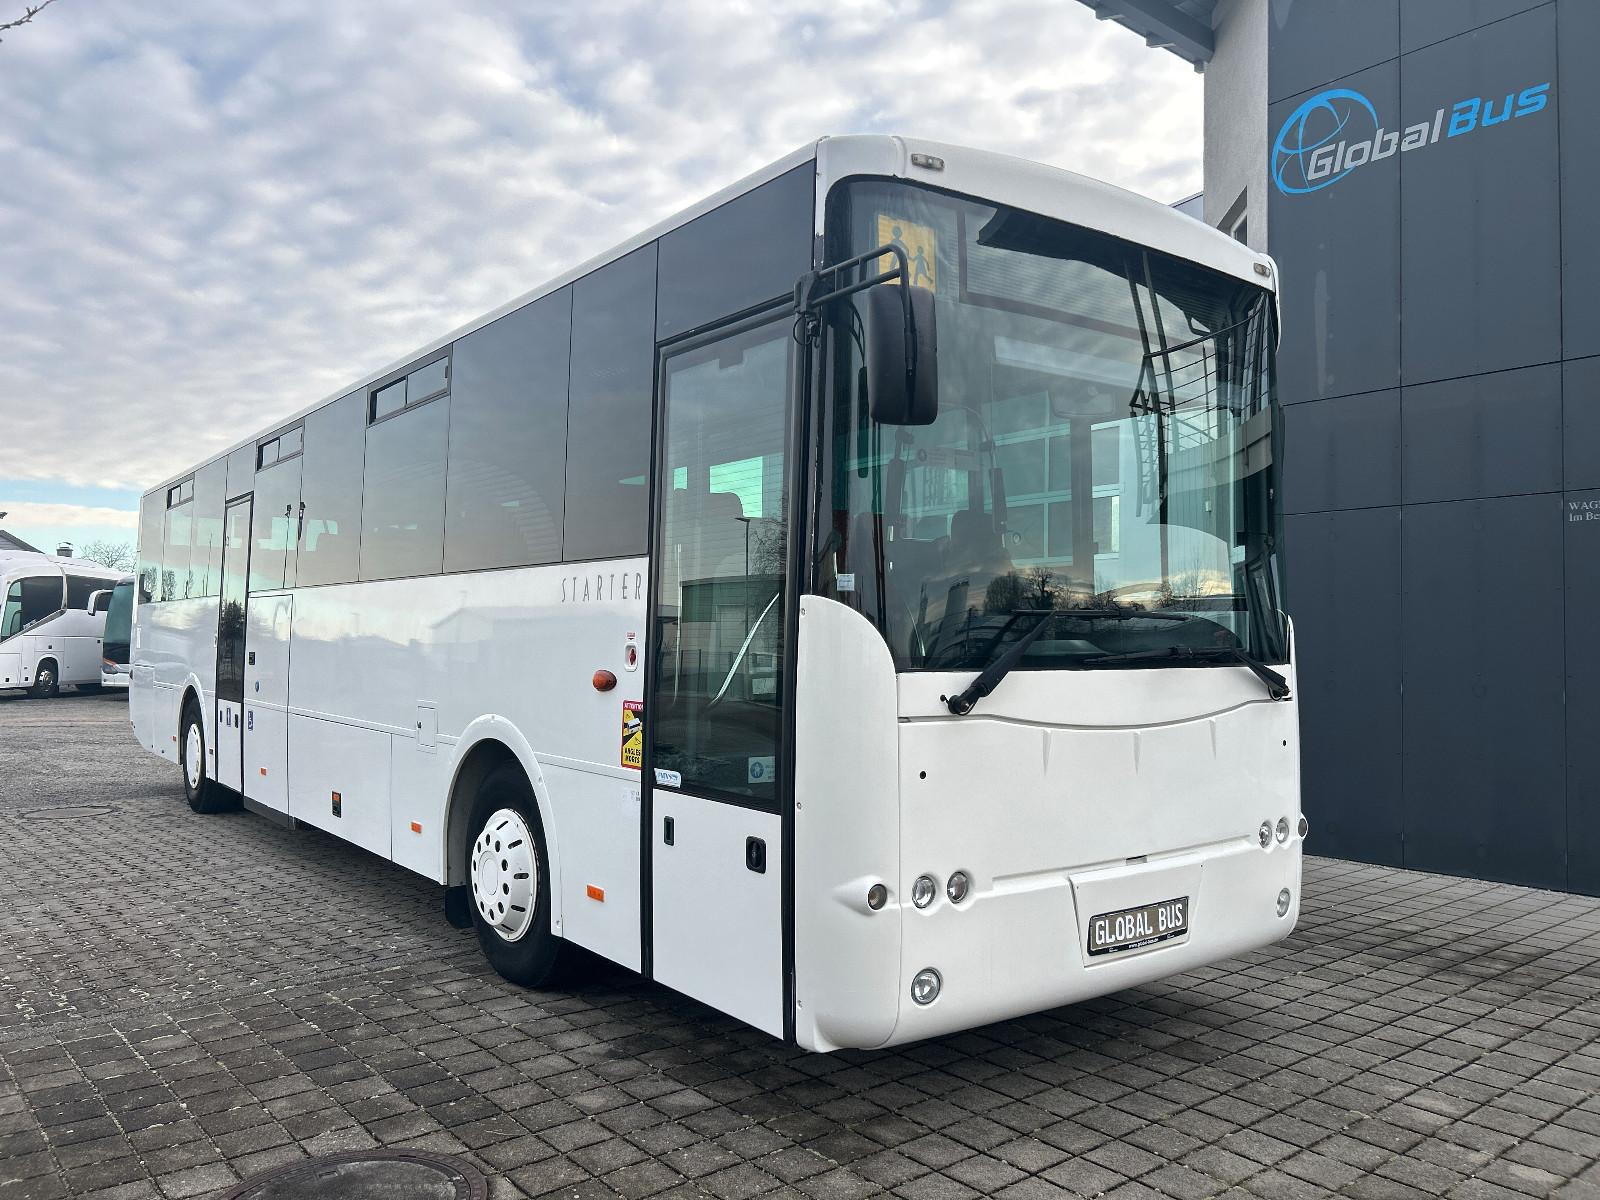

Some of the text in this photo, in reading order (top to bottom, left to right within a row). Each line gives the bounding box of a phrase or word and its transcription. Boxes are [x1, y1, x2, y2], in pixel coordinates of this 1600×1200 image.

[1568, 500, 1600, 510] WAG
[1569, 512, 1583, 522] Im
[561, 572, 642, 602] STARTER
[1095, 903, 1183, 945] GLOBAL BUS
